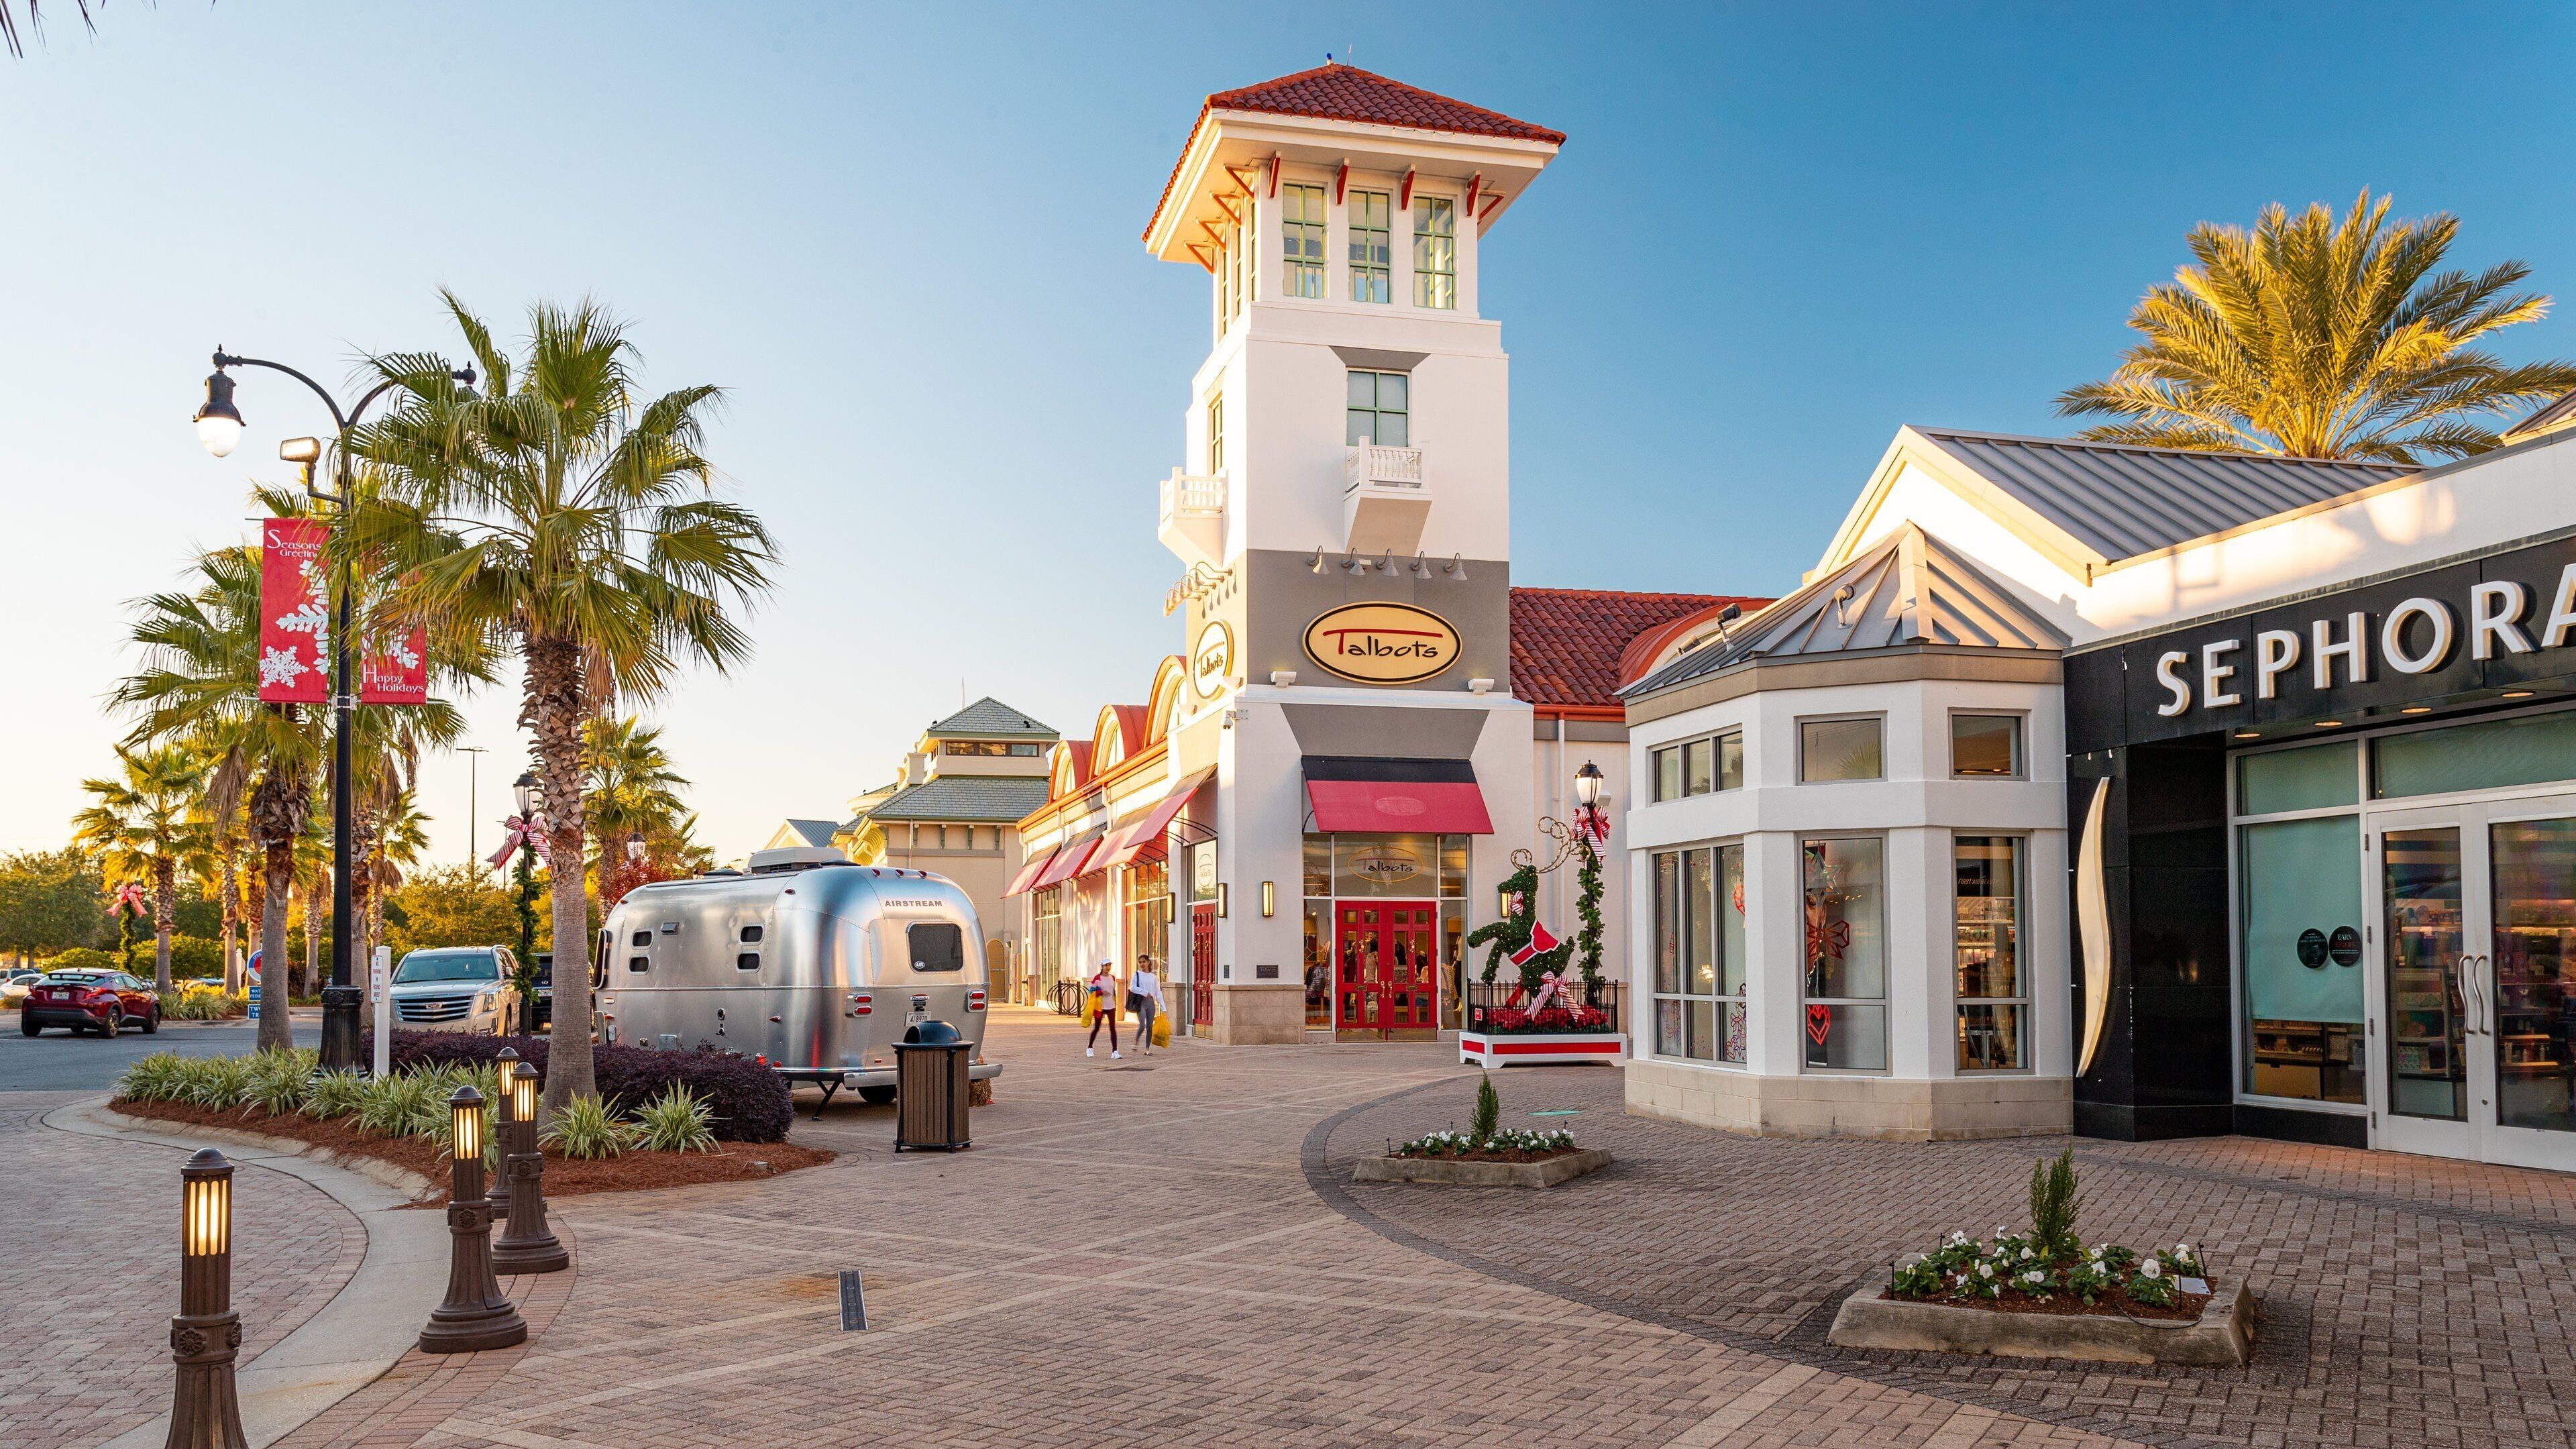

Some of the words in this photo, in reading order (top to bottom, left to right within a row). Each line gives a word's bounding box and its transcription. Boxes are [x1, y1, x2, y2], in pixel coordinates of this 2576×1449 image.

[267, 529, 322, 550] Seasons
[280, 549, 318, 558] Greetin
[1323, 628, 1444, 659] Talbots
[1197, 641, 1225, 679] Talbots
[363, 664, 404, 684] Happy
[378, 684, 425, 694] Holidays
[1356, 857, 1415, 873] Talbots
